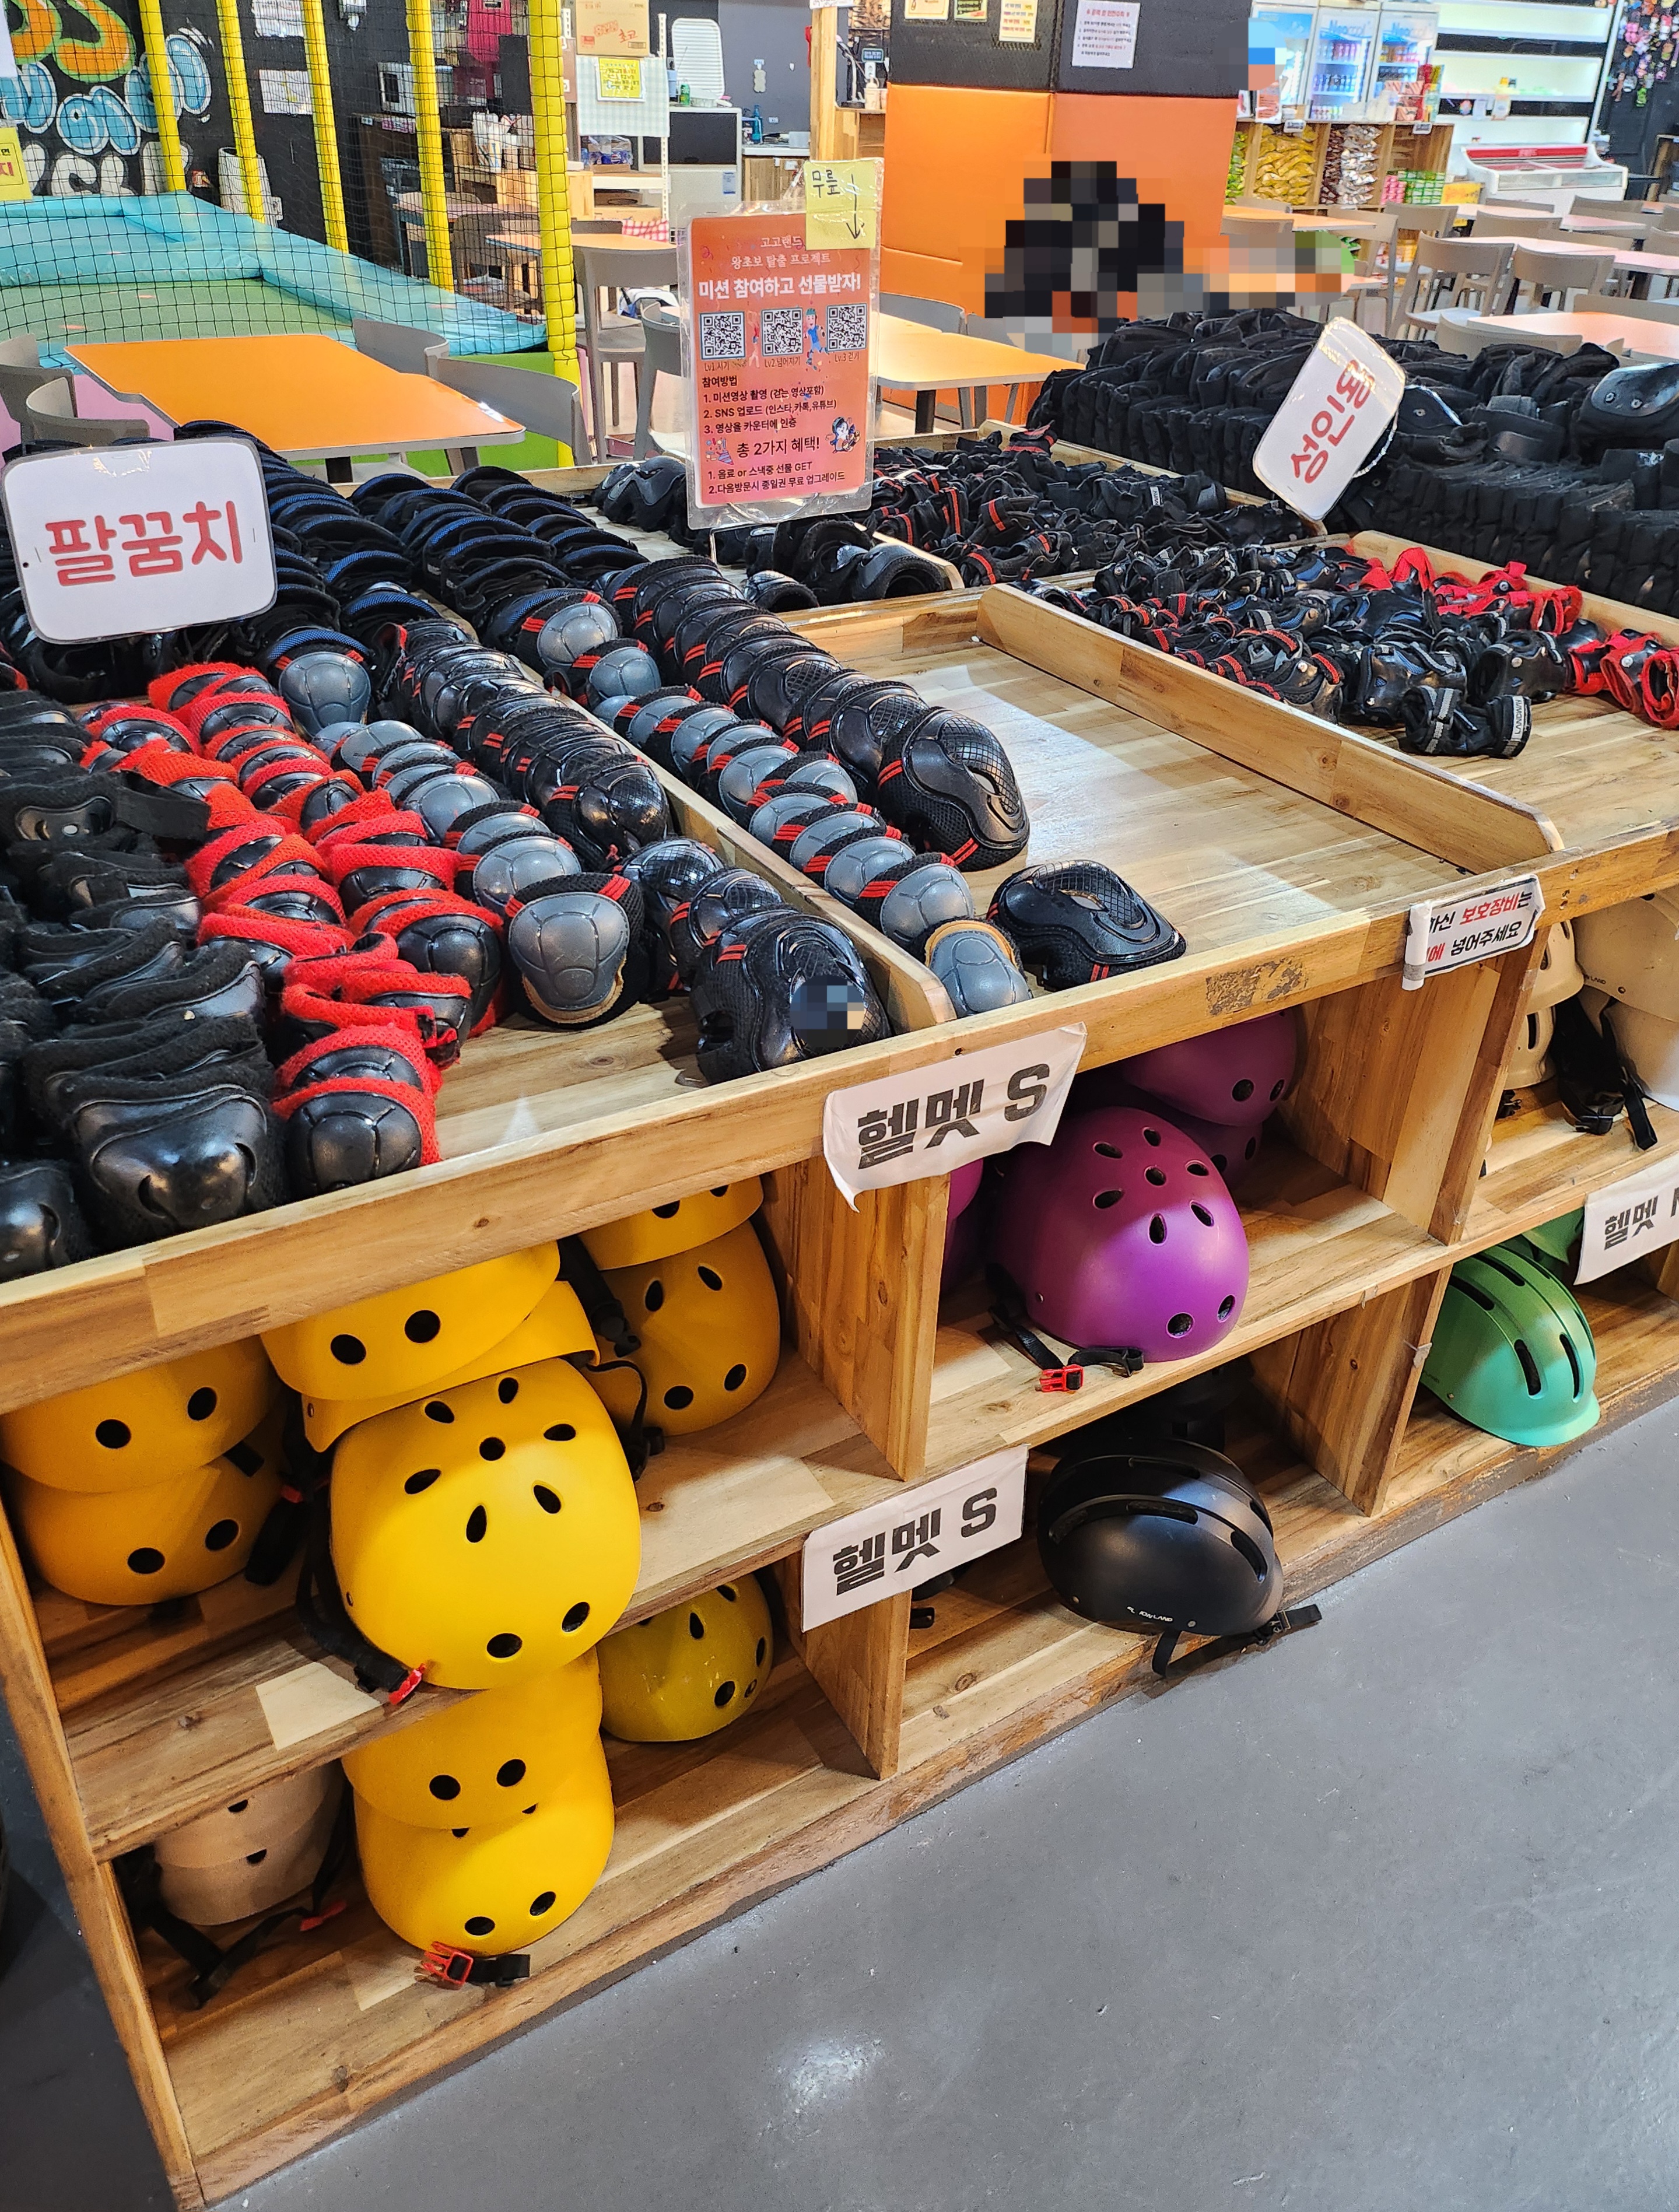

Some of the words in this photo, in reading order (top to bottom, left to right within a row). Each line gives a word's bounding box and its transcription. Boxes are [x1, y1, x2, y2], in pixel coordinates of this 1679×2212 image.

[812, 169, 840, 198] 무릎
[760, 235, 802, 248] 고고랜드
[731, 255, 763, 269] 왕초보
[766, 254, 787, 268] 탈출
[790, 253, 831, 265] 프로젝트
[699, 279, 730, 300] 미션
[734, 276, 795, 299] 참여하고
[798, 272, 861, 295] 선물받자!
[702, 375, 737, 388] 참여방법
[703, 394, 711, 403] 1.
[713, 391, 748, 403] 미션영상
[751, 389, 767, 400] 촬영
[770, 388, 789, 399] (걷는
[791, 385, 824, 398] 영상포함)
[704, 410, 712, 419] 2.
[715, 408, 734, 418] SNS
[737, 405, 763, 416] 업로드
[1291, 359, 1376, 484] 성인용
[704, 425, 713, 434] 3.
[716, 422, 742, 434] 영상을
[744, 419, 777, 432] 카운터에
[780, 418, 797, 429] 인증
[737, 443, 749, 458] 총
[754, 439, 787, 455] 2가지
[791, 436, 819, 453] 혜택!
[708, 471, 716, 479] 1.
[718, 469, 735, 479] 음료
[749, 465, 774, 476] 스낵중
[776, 464, 793, 474] 선물
[794, 461, 812, 471] GET
[762, 478, 786, 490] 종일권
[788, 476, 804, 488] 무료
[806, 471, 845, 485] 업그레이드
[45, 500, 243, 586] 팔꿈치
[1459, 891, 1533, 925] 보호장비는
[857, 1079, 984, 1170] 헬멧
[1004, 1063, 1050, 1122] S
[1604, 1195, 1659, 1251] 헬멧
[833, 1508, 941, 1596] 헬멧
[961, 1487, 997, 1538] S
